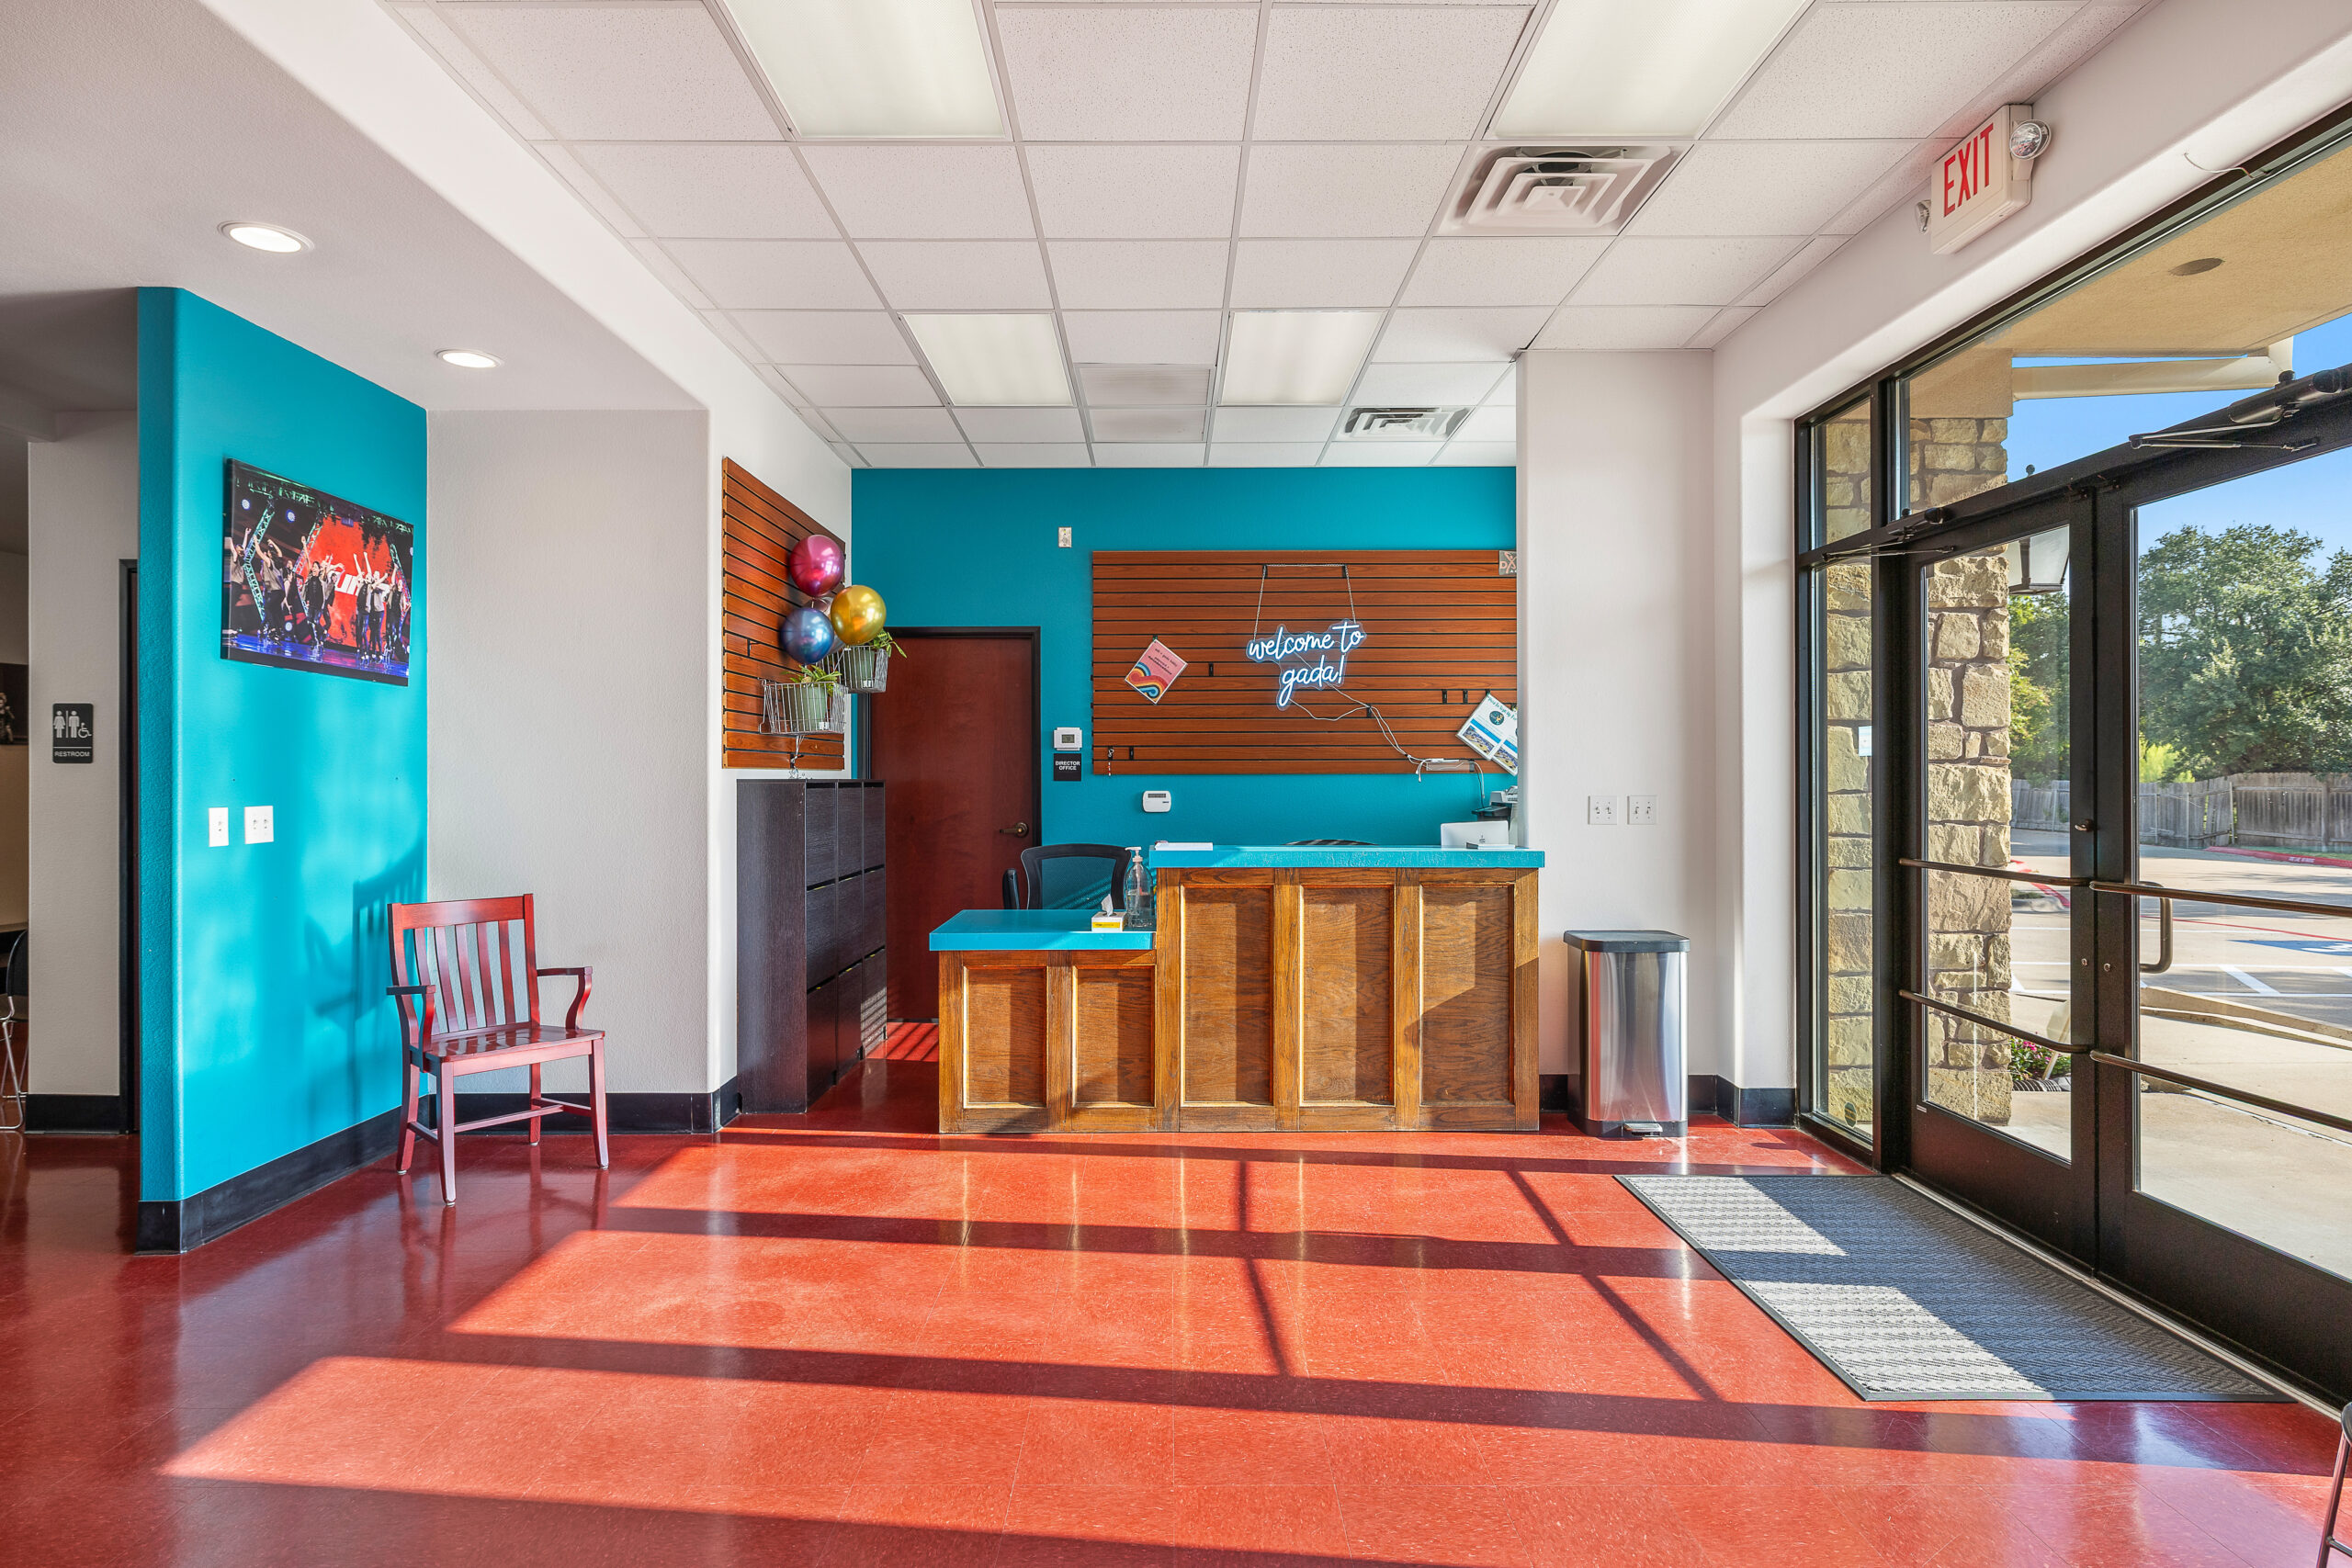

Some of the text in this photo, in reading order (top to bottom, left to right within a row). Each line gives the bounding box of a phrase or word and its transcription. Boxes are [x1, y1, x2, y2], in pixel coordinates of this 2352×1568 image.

[1943, 122, 1994, 218] EXIT
[1249, 621, 1364, 660] welcome to
[1279, 654, 1345, 706] gada!
